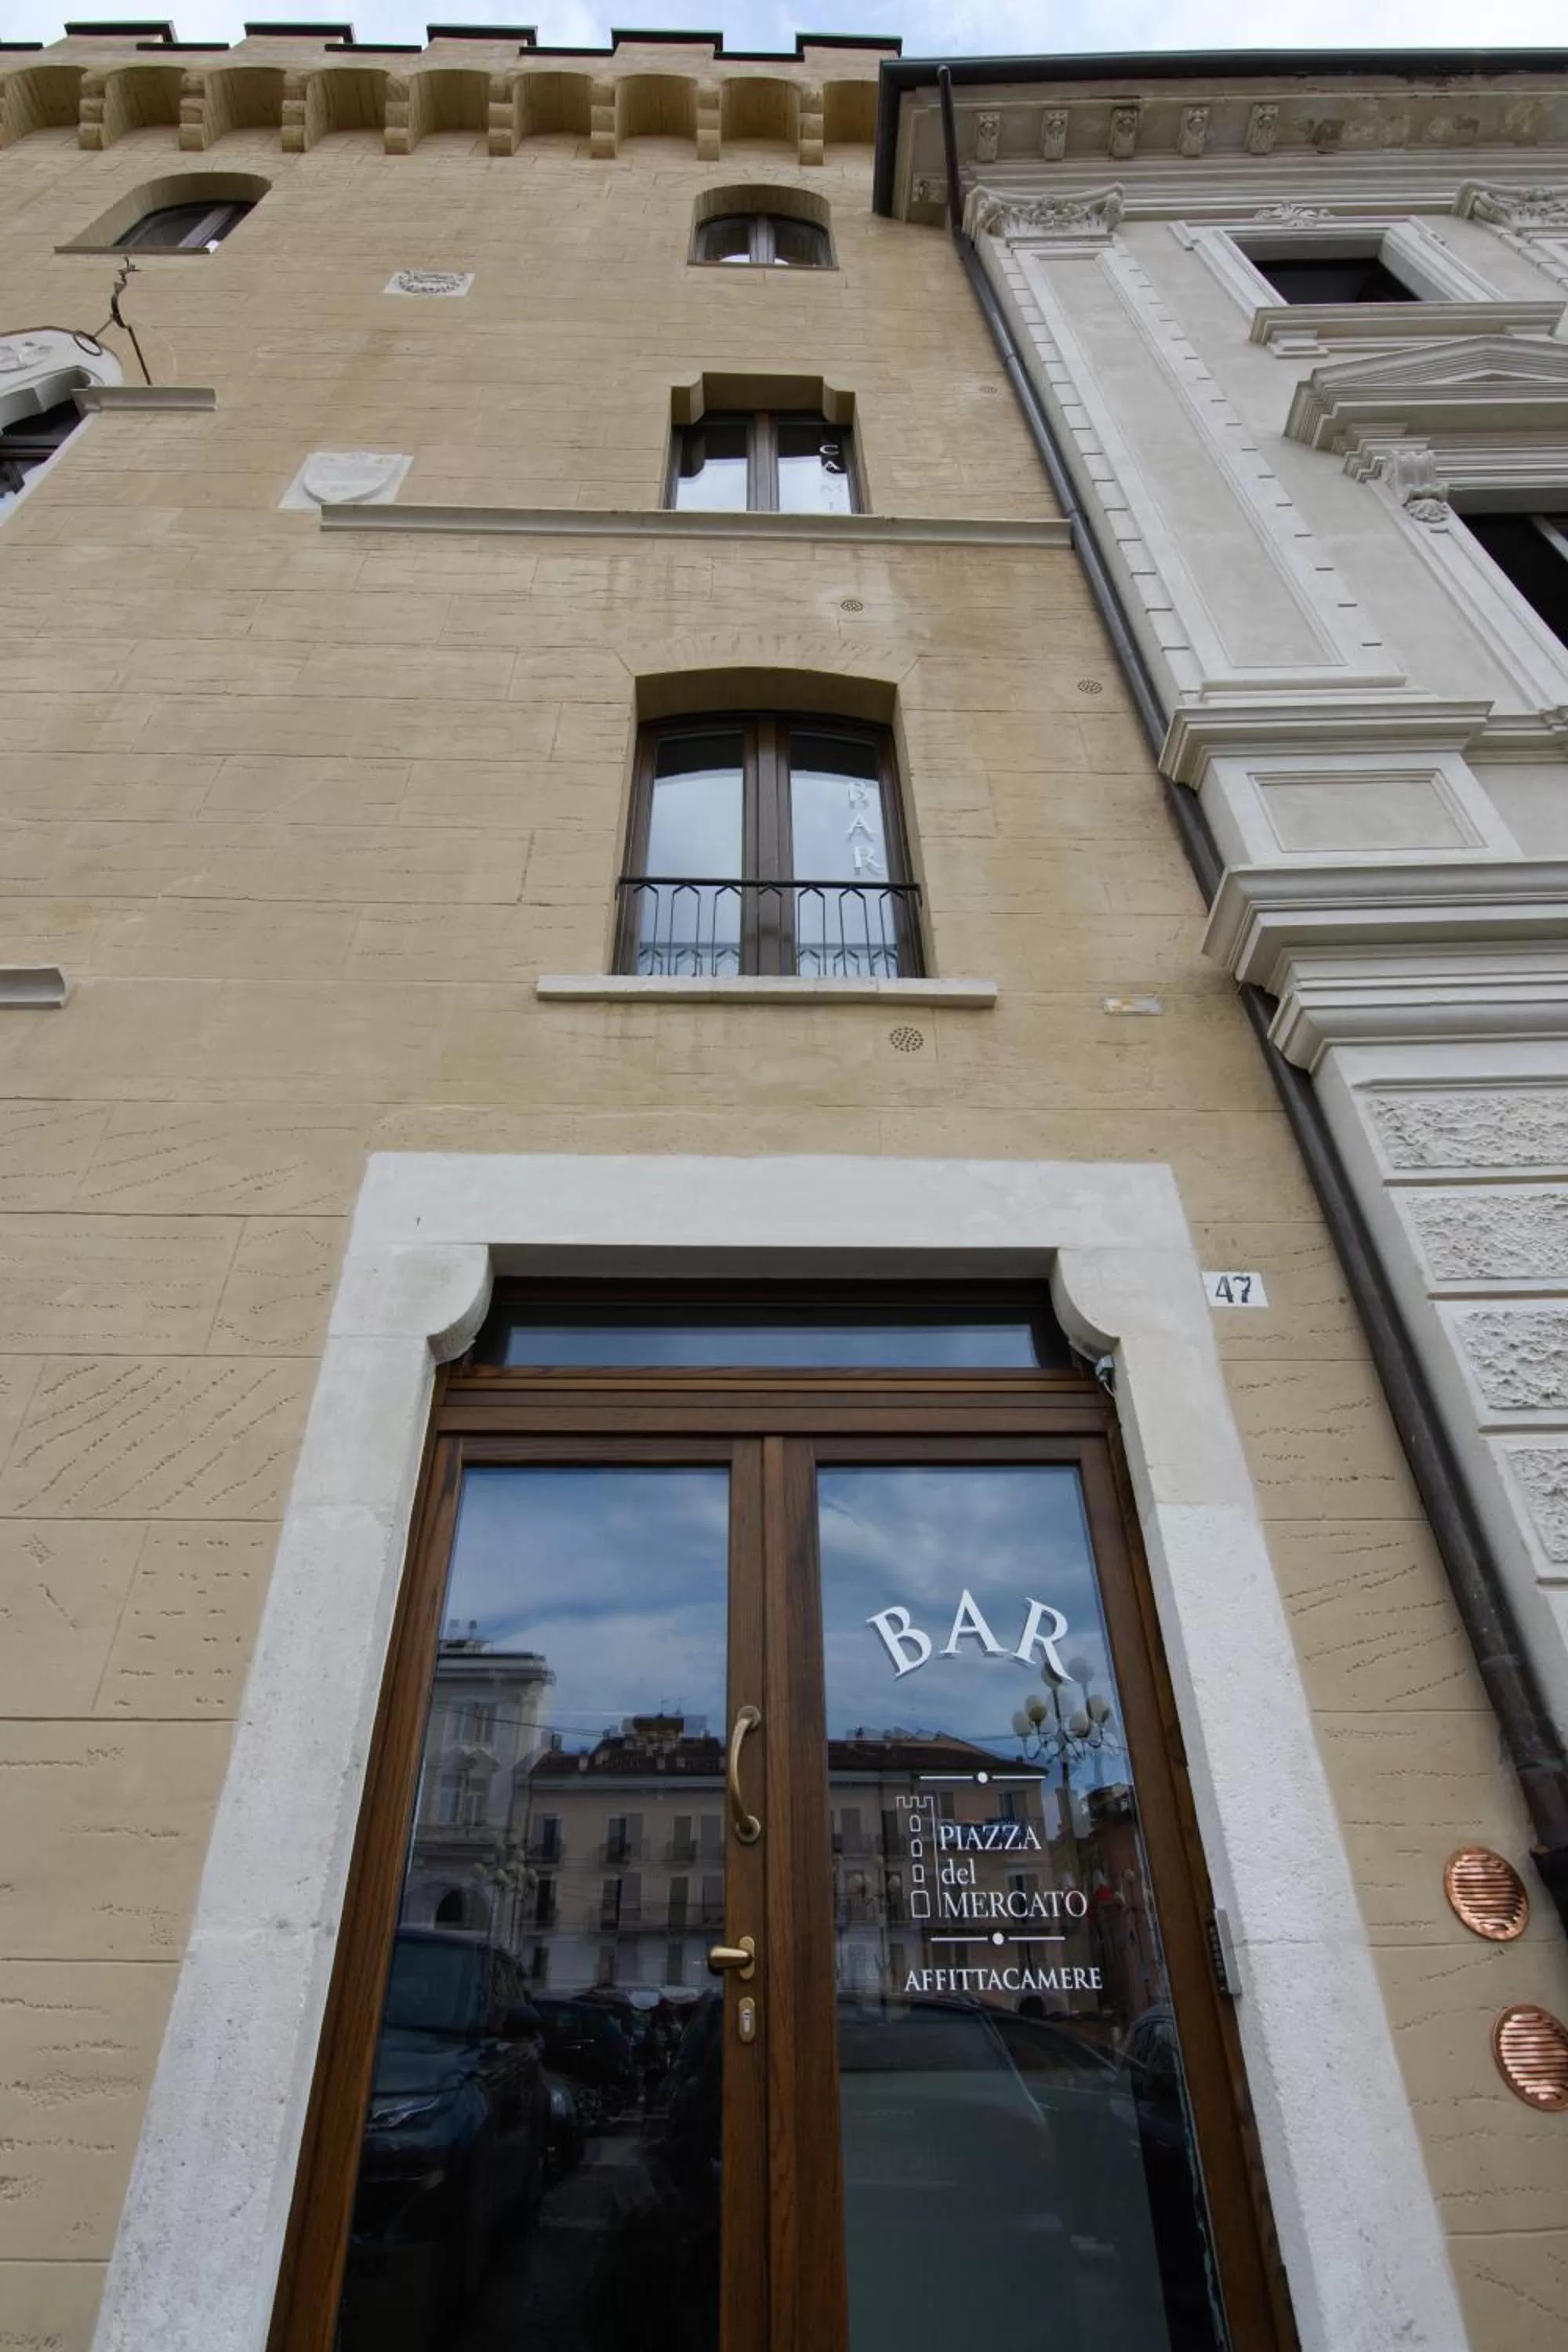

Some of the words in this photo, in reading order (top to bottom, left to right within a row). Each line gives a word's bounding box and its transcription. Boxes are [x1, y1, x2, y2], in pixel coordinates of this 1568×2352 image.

[848, 782, 881, 872] BAR
[1215, 1276, 1251, 1303] 47
[865, 1588, 1074, 1682] BAR
[940, 1824, 1042, 1851] PIAZZA
[941, 1857, 976, 1886] del
[943, 1890, 1088, 1918] MERCATO
[904, 1966, 1103, 1992] AFFITTACAMERE
